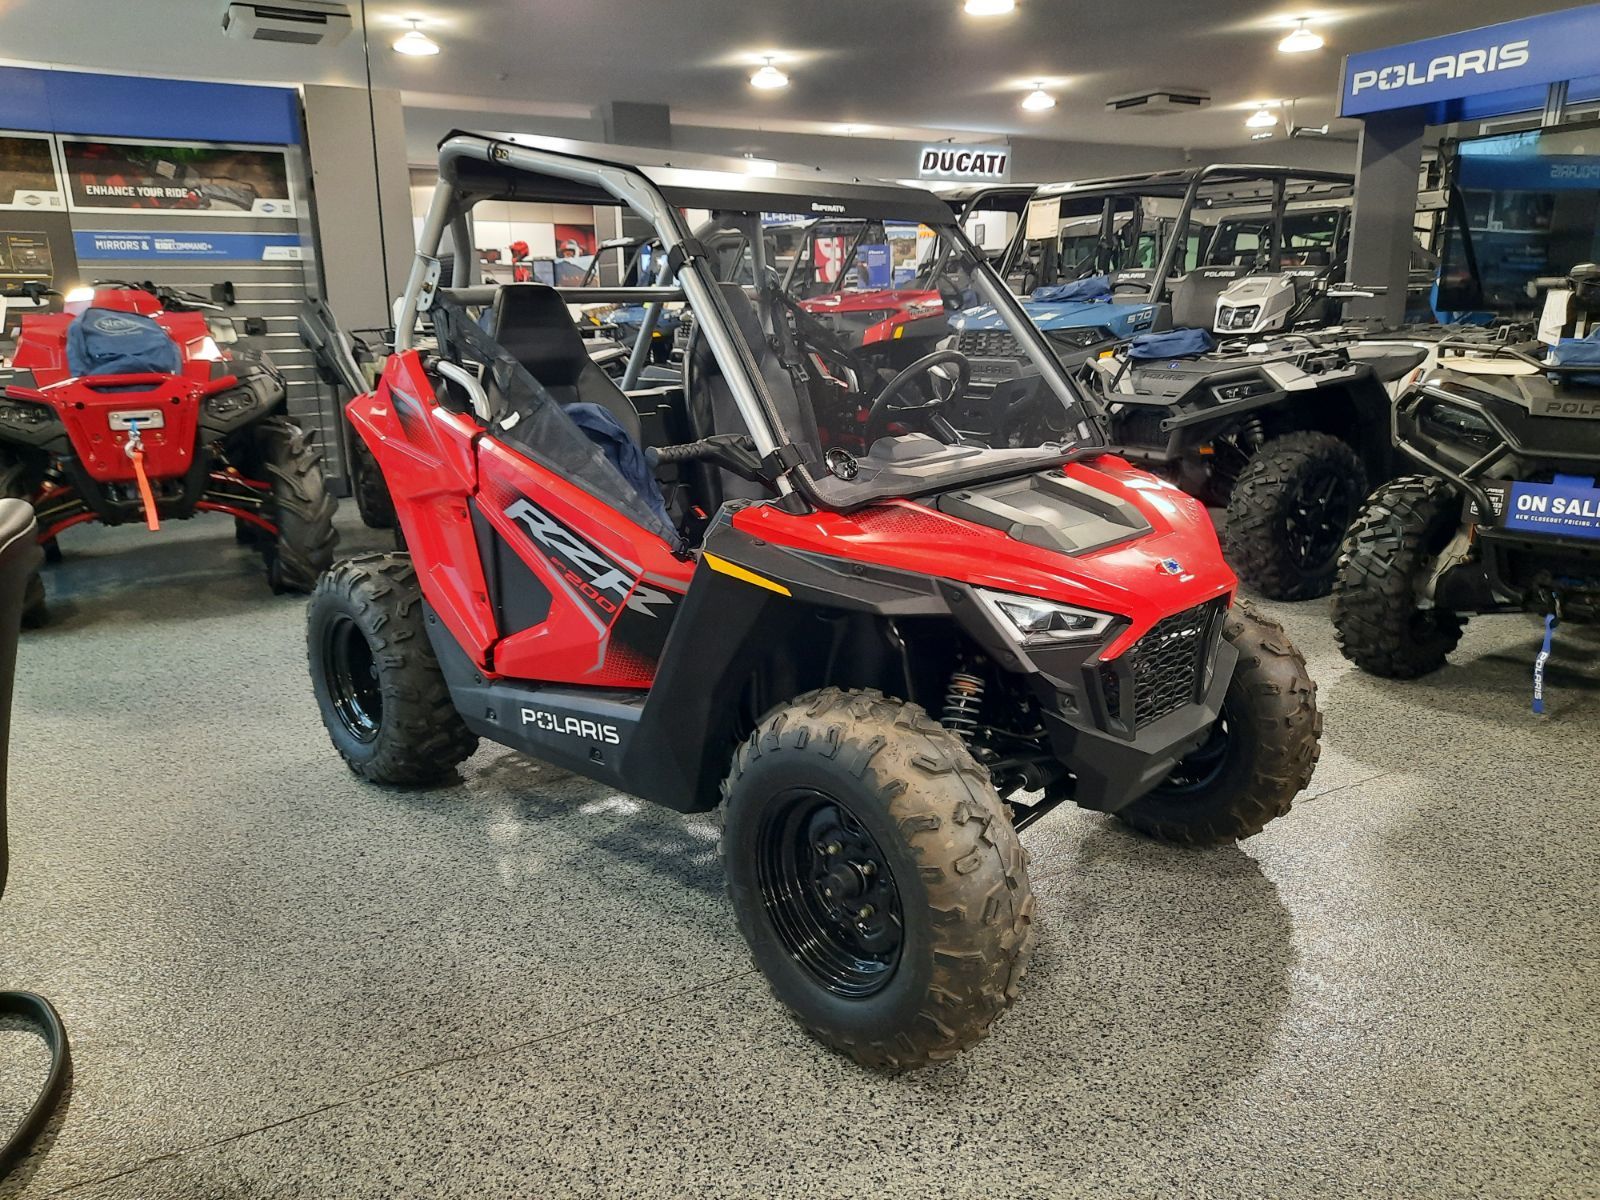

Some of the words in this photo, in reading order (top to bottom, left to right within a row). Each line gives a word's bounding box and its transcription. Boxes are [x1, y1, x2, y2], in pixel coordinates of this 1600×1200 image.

[1351, 40, 1529, 95] POLARIS
[922, 151, 1007, 174] DUCATI
[85, 185, 135, 196] ENHANCE
[136, 187, 163, 198] YOUR
[164, 188, 189, 198] RIDE
[95, 240, 139, 251] MIRRORS
[141, 241, 149, 251] &
[1117, 272, 1146, 280] POLARIS
[1517, 494, 1548, 513] ON
[1530, 515, 1562, 524] CLOSEOUT
[503, 498, 674, 619] RZR
[564, 569, 617, 614] 200
[1533, 651, 1550, 701] POLARIS
[520, 707, 620, 745] POLARIS
